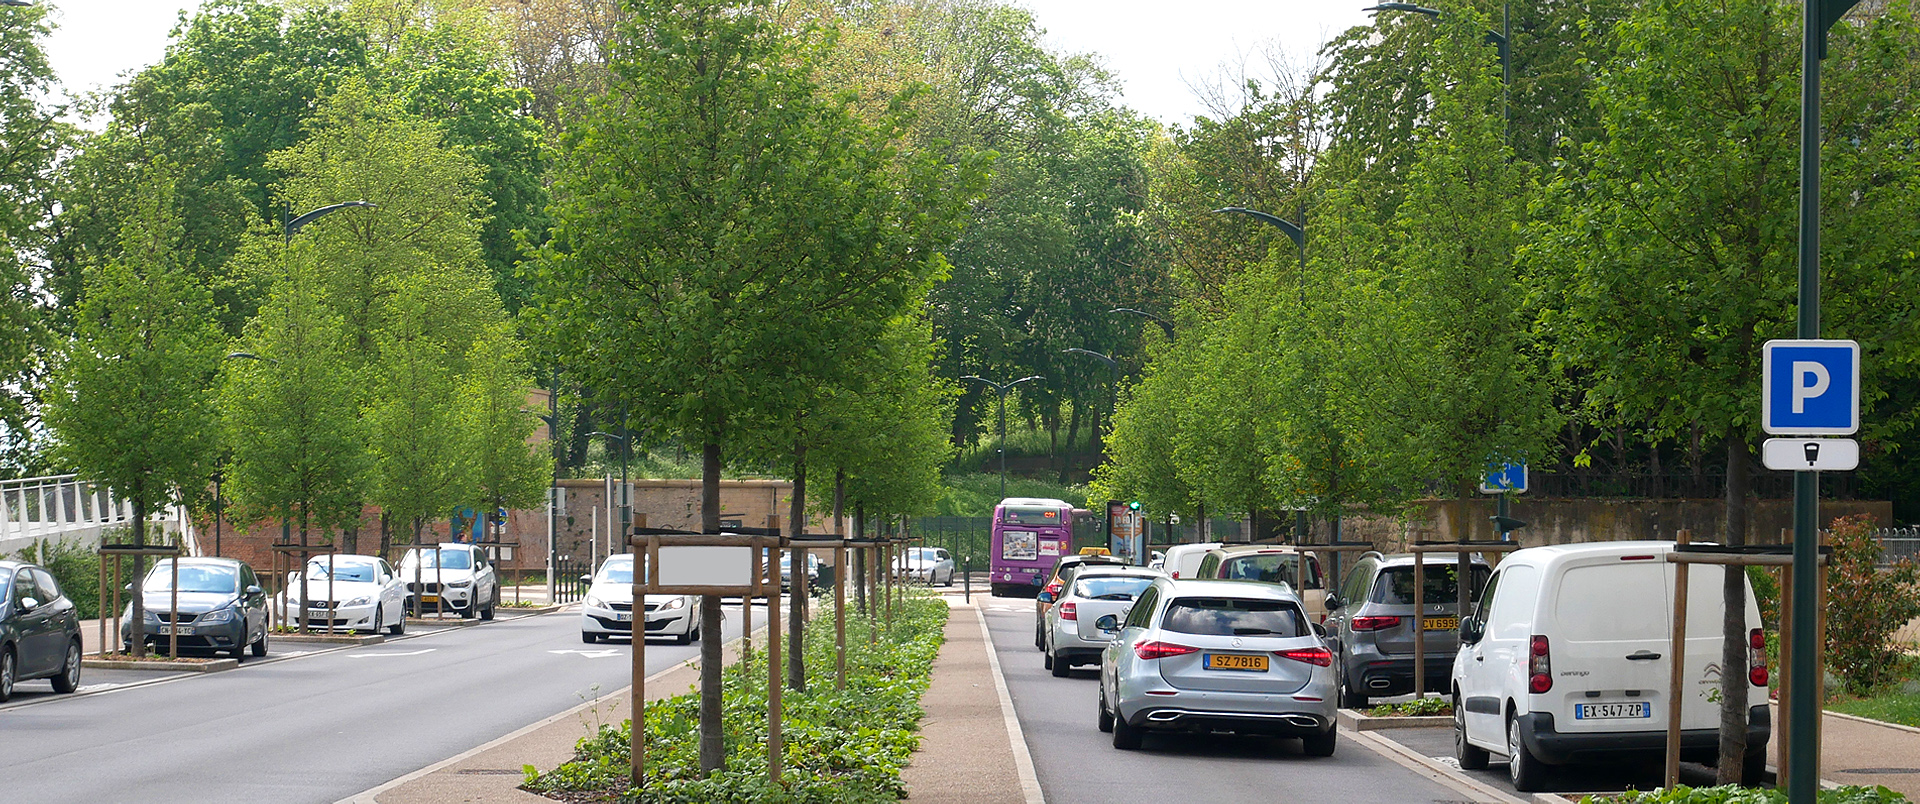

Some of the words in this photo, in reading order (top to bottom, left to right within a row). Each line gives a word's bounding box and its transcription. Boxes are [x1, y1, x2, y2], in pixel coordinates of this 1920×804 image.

[1792, 361, 1830, 413] P
[1216, 656, 1231, 667] SZ
[1233, 657, 1262, 668] 7816
